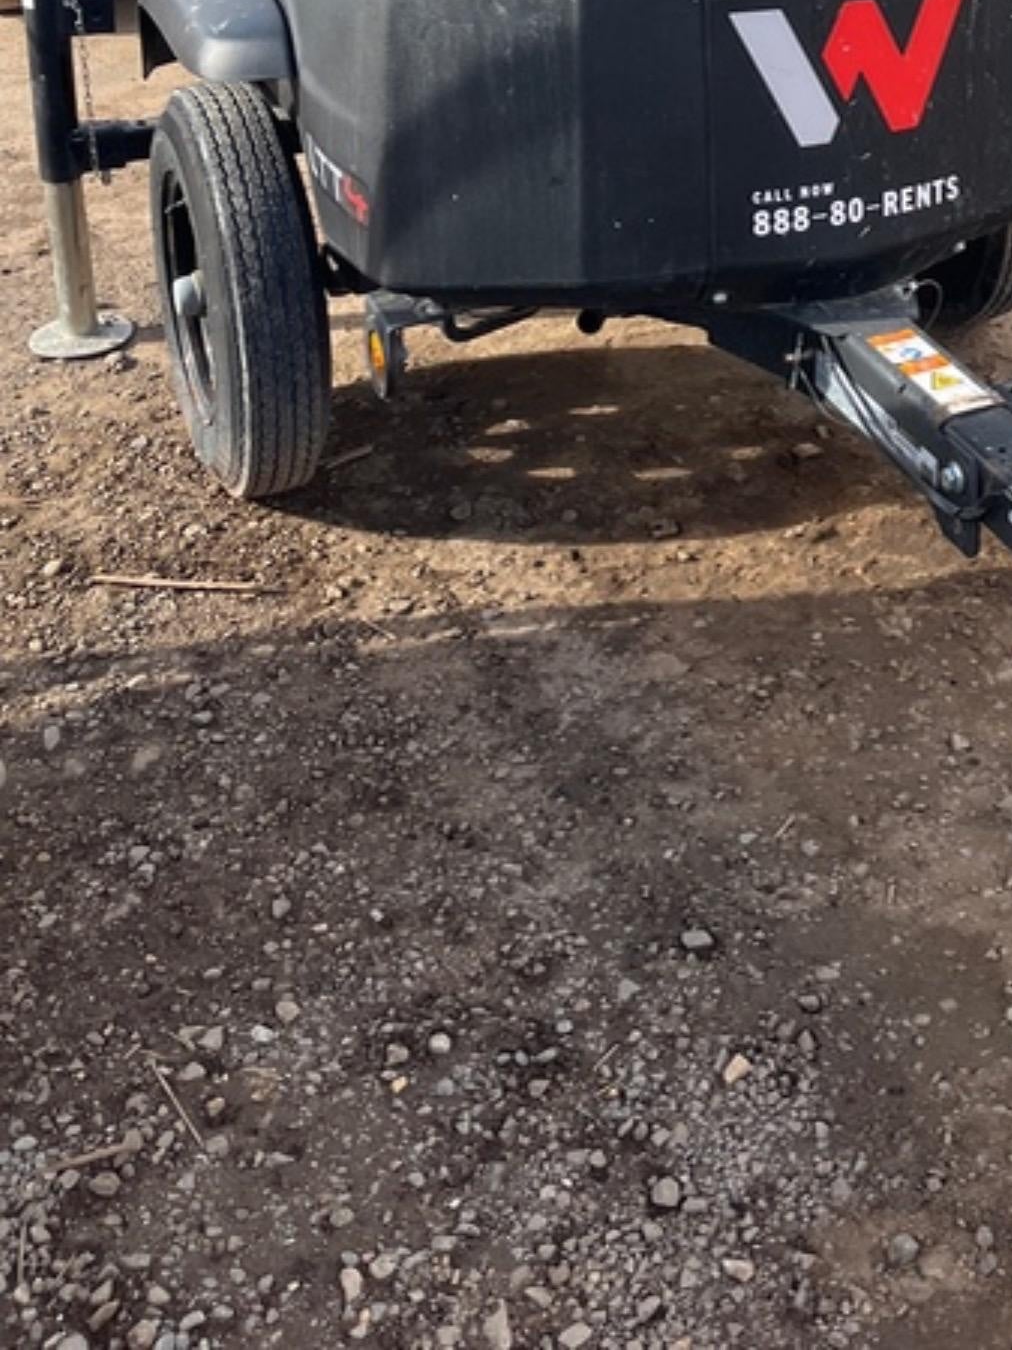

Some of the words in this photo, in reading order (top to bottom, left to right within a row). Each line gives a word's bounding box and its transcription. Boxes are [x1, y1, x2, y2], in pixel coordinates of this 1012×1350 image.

[752, 188, 793, 204] CALL
[800, 182, 835, 199] NOW
[752, 174, 960, 237] 888-80-RENTS
